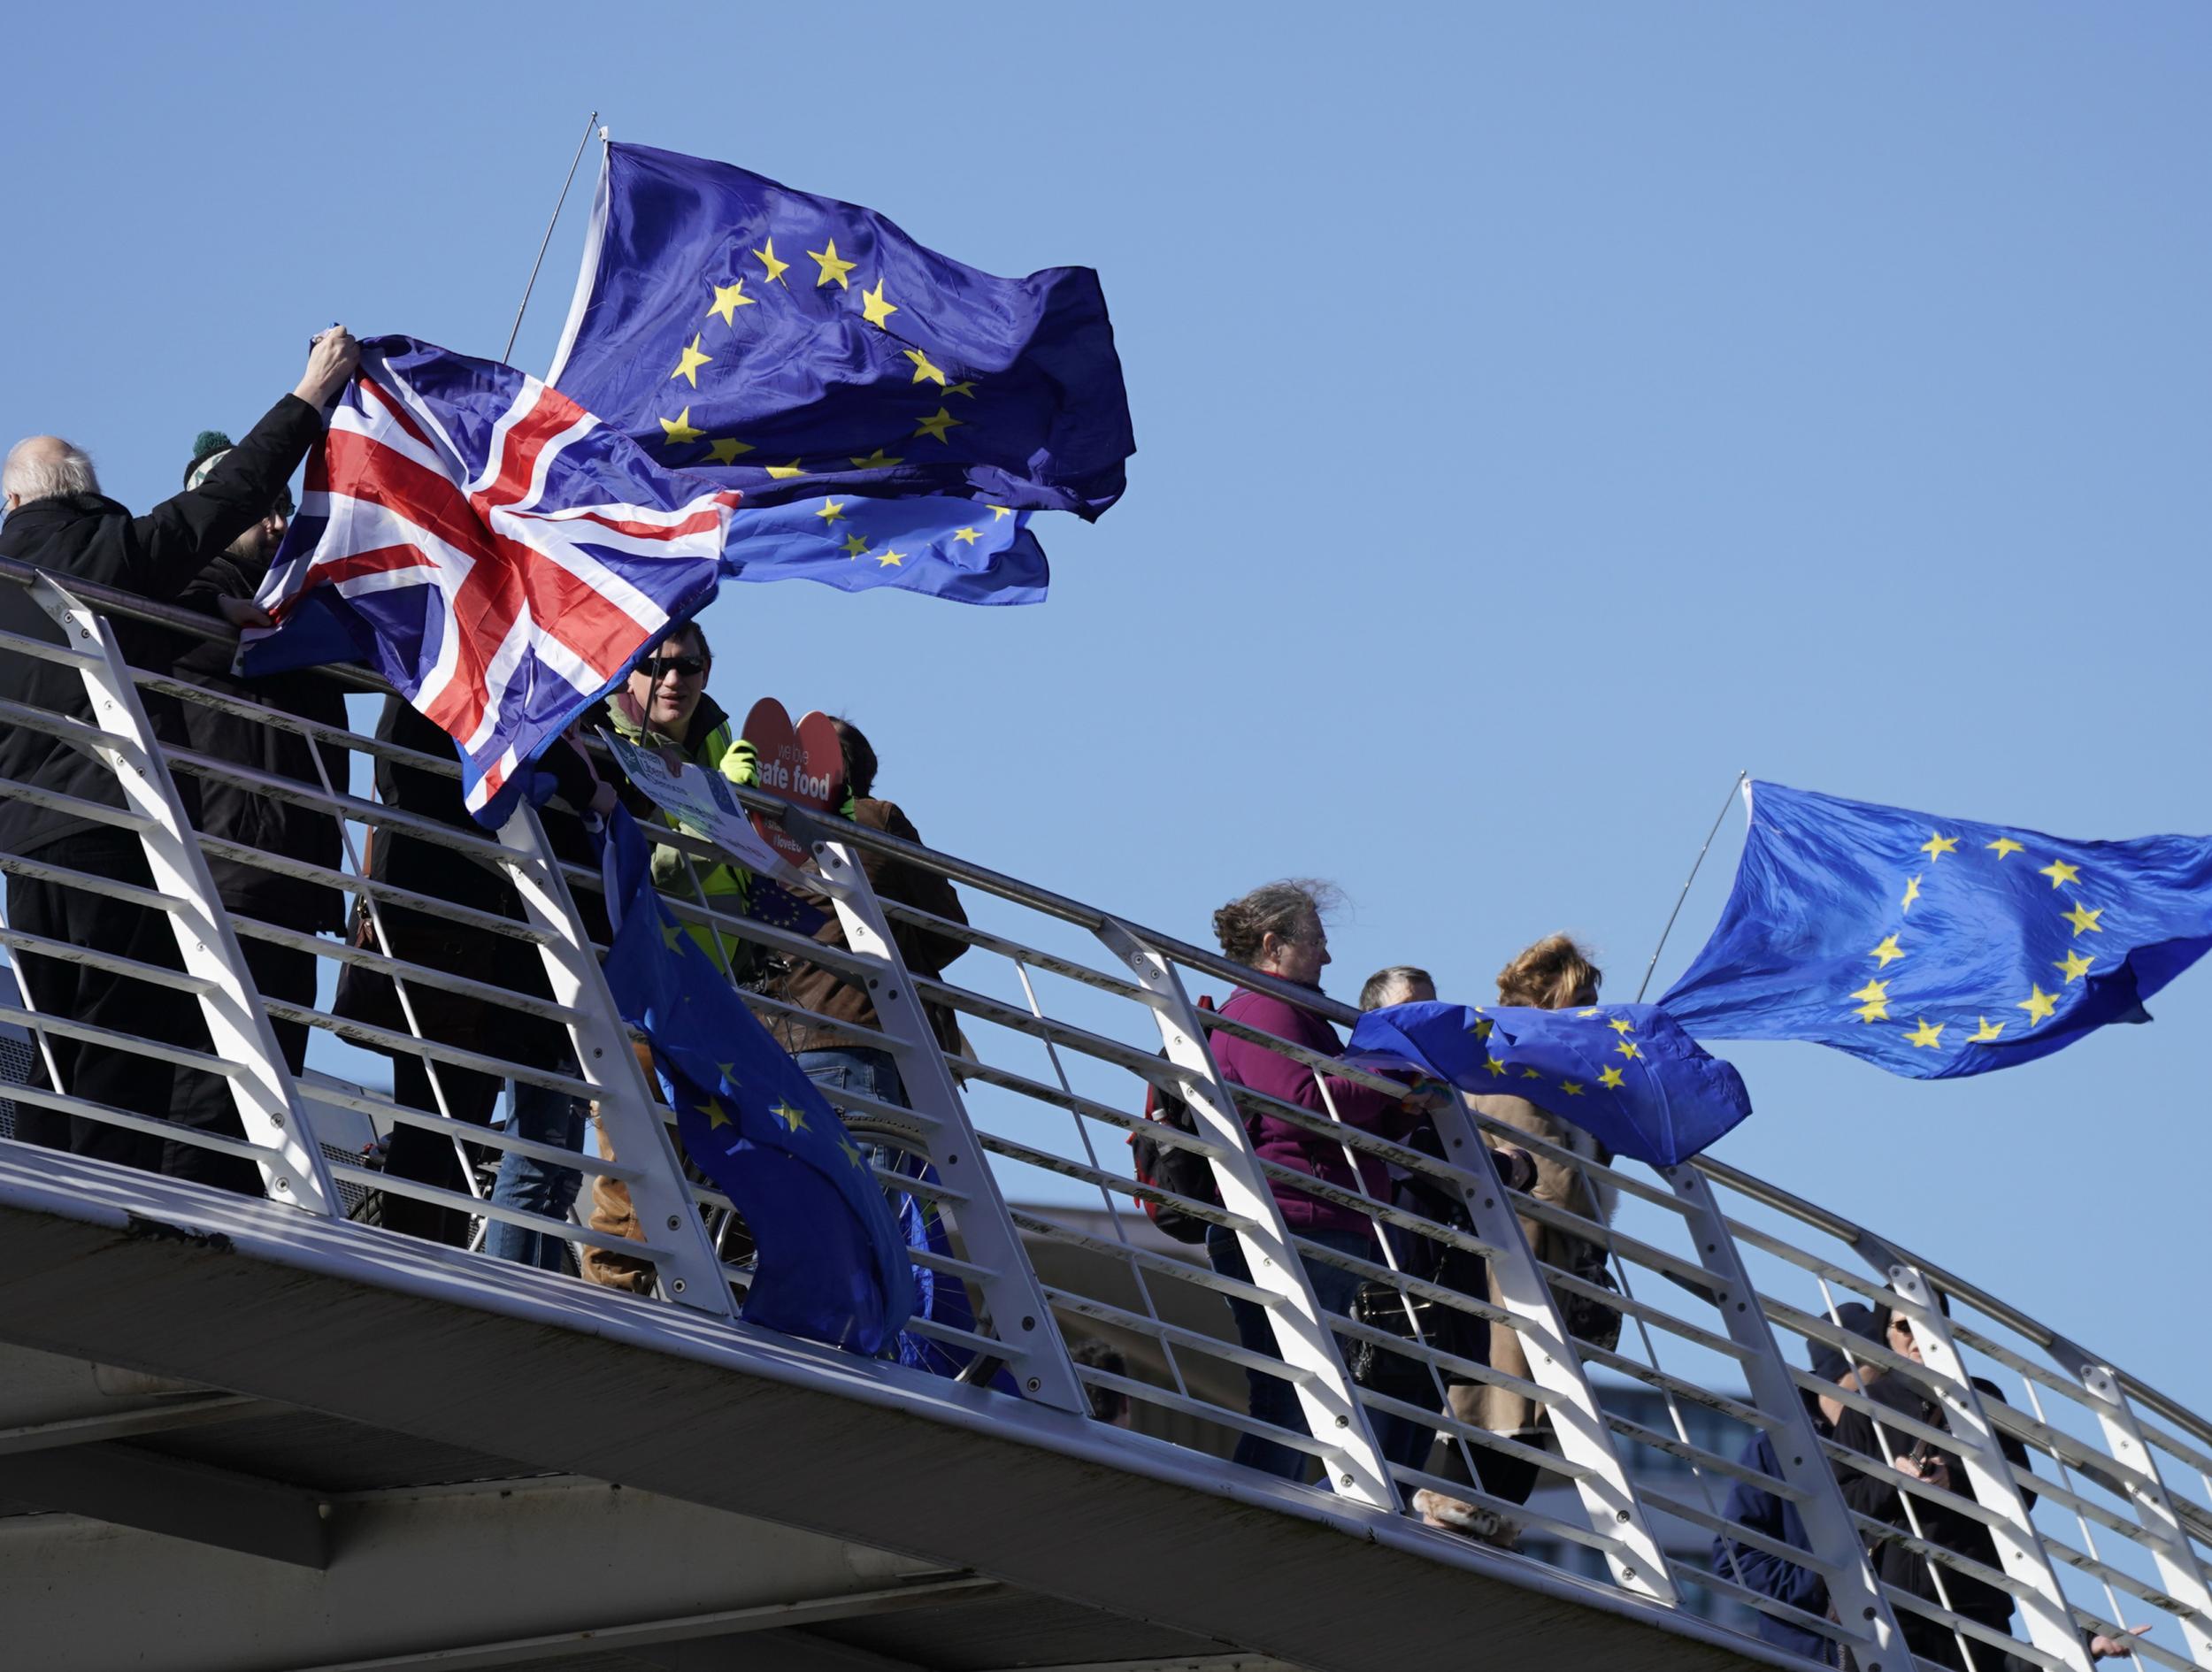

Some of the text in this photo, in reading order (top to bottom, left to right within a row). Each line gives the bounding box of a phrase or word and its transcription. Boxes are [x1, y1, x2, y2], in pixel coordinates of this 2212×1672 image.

[778, 743, 809, 765] we love
[756, 758, 831, 801] safe food
